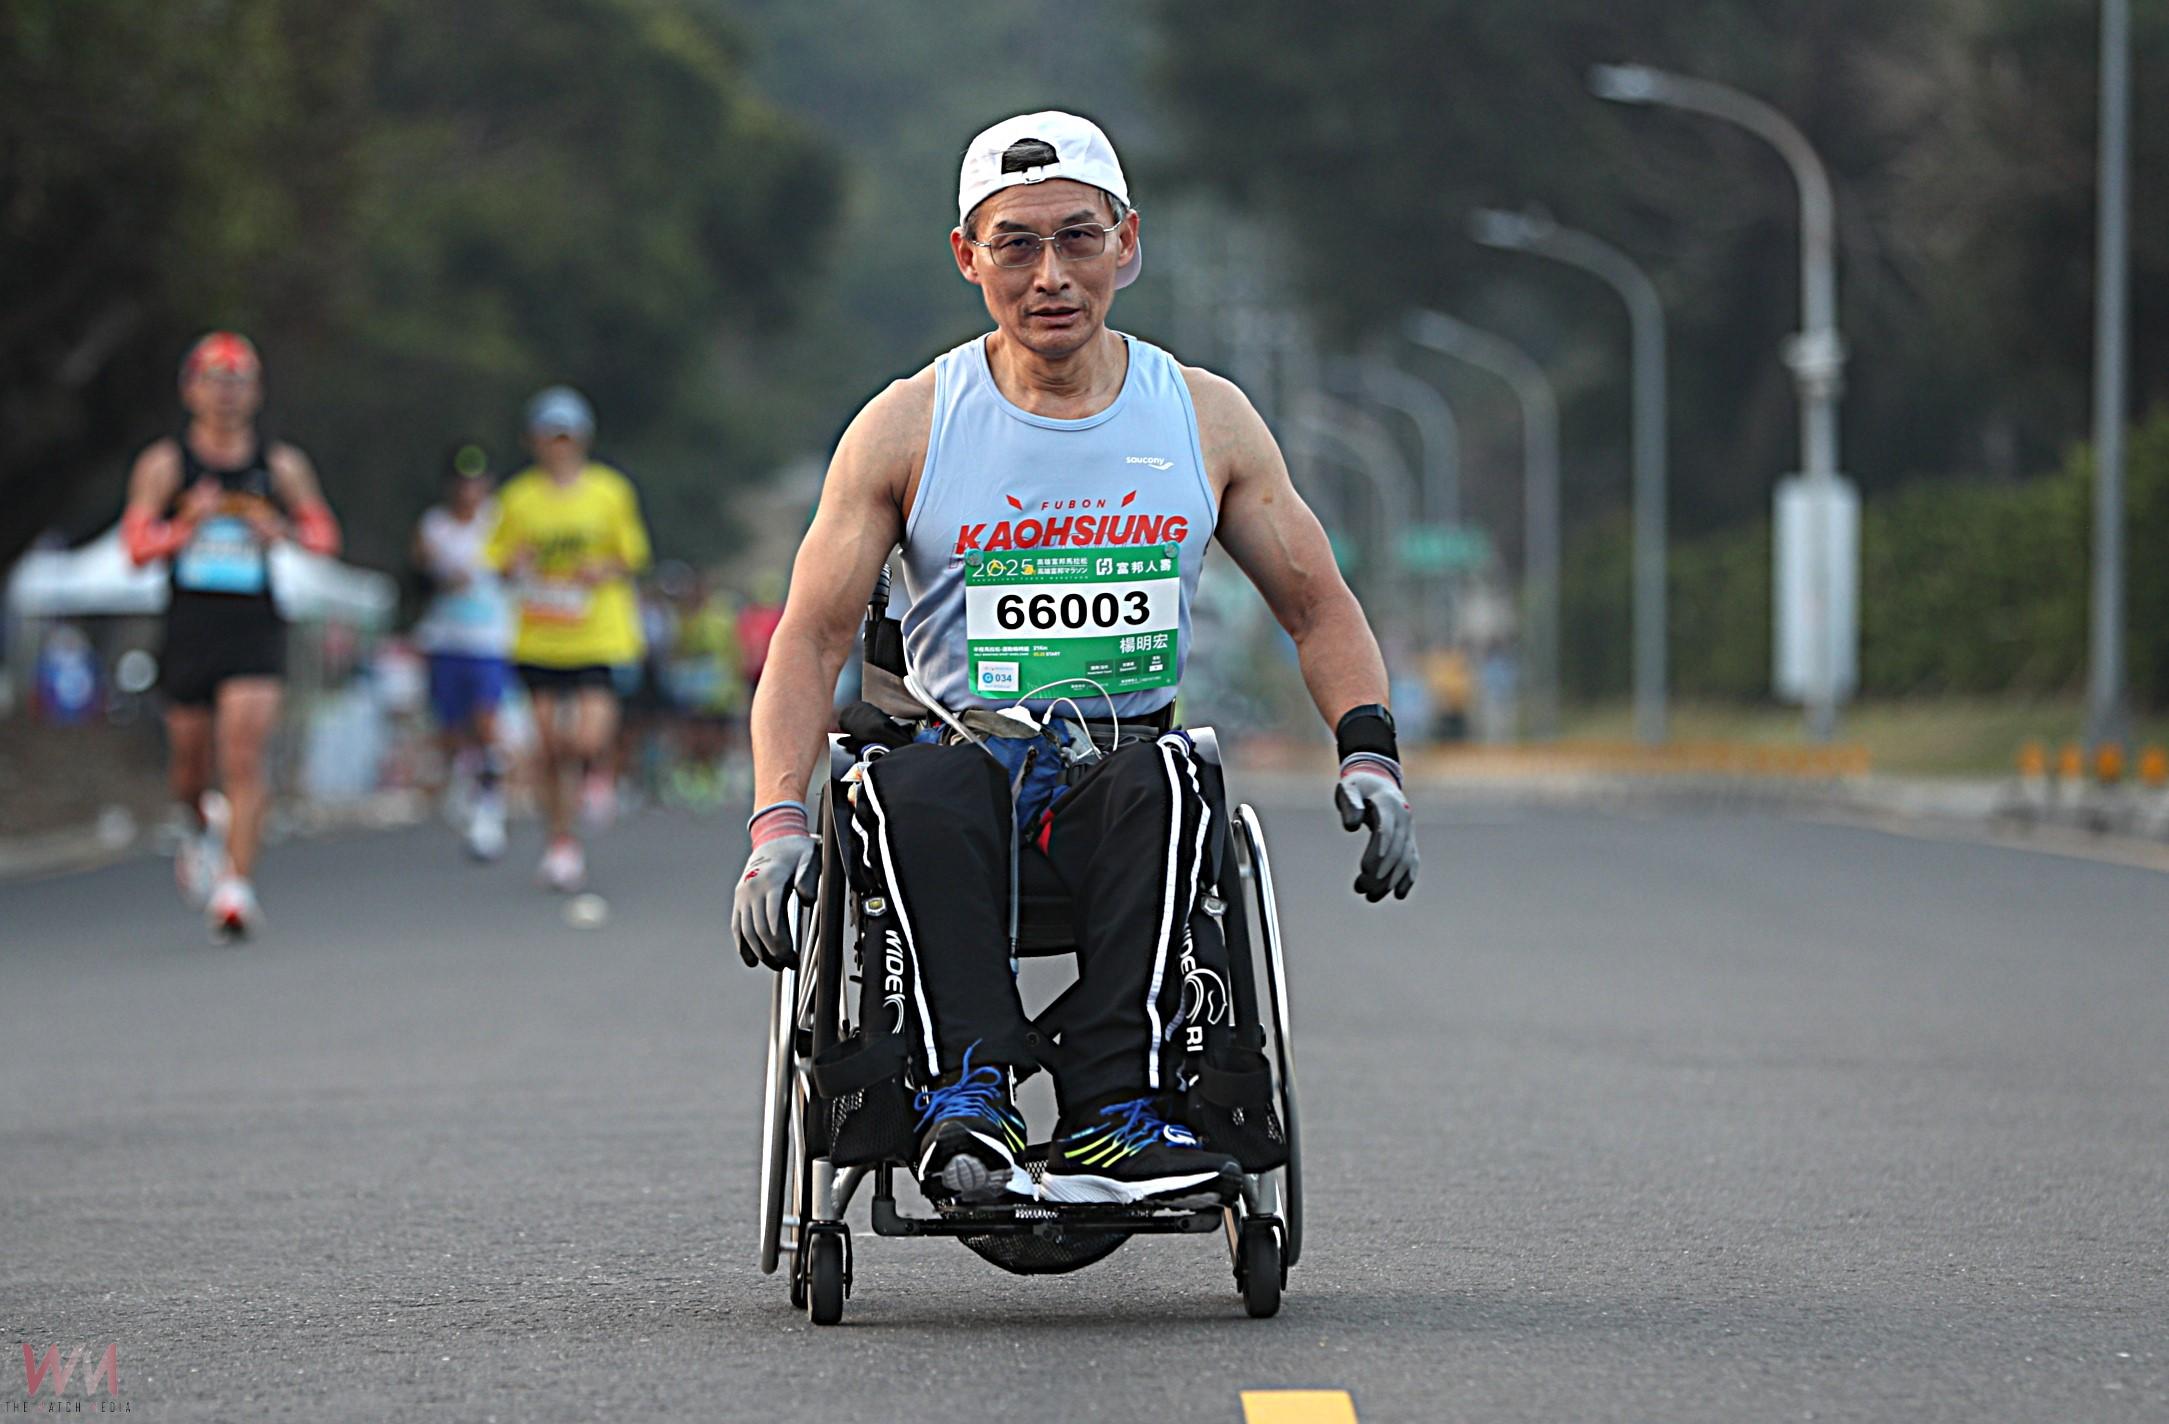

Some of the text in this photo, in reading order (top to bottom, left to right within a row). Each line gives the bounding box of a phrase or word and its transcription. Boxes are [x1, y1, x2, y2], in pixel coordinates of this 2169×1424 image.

[1126, 456, 1165, 466] saucony
[1040, 498, 1107, 511] FUBON
[954, 514, 1189, 555] KAOHSIUNG
[972, 558, 1033, 577] 2025
[1116, 558, 1172, 576] 富邦人壽
[996, 590, 1151, 630] 66003
[1119, 633, 1169, 654] 楊明宏
[995, 673, 1012, 682] 034
[885, 929, 904, 994] WIDE
